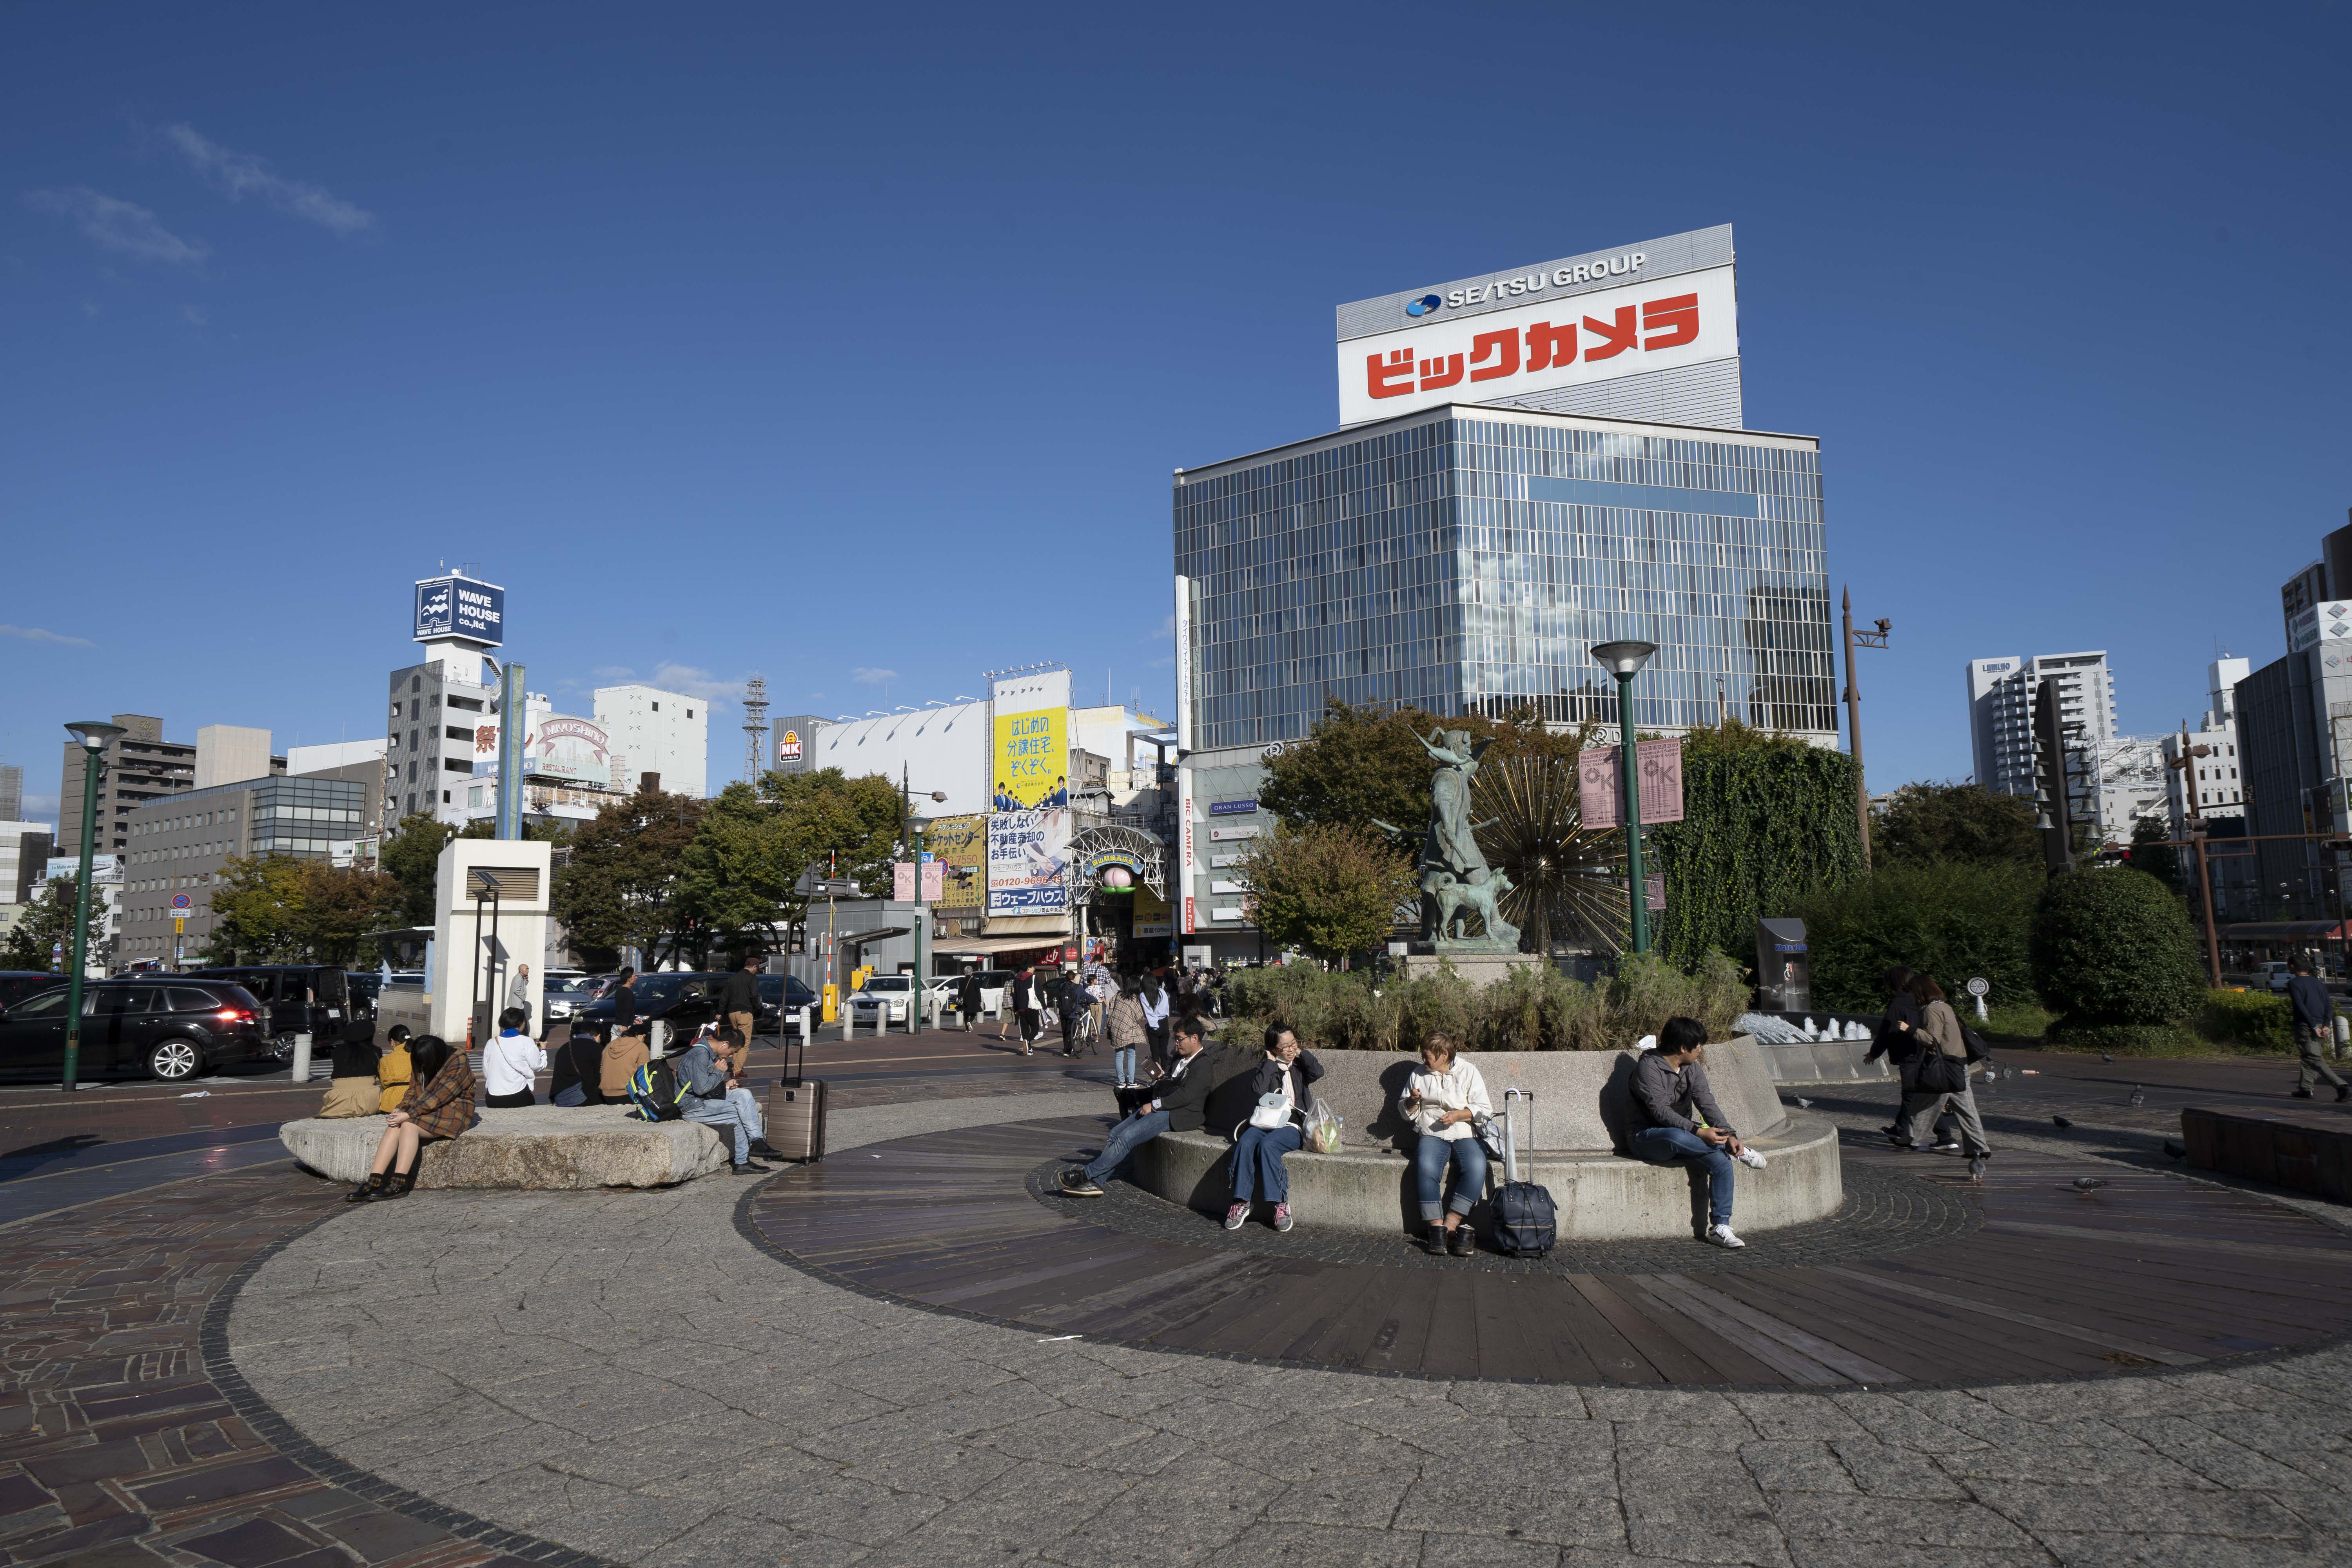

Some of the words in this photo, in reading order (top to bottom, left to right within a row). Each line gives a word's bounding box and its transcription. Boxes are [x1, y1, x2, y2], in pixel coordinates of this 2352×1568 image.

[1552, 252, 1646, 287] GROUP
[1367, 292, 1700, 399] ビックカメラ
[458, 589, 492, 608] WAVE
[459, 603, 500, 623] HOUSE
[546, 722, 605, 744] MIYOSHINO
[1012, 717, 1049, 736] はじめの
[781, 743, 800, 755] NK
[1007, 736, 1054, 757] 分譲住宅、
[1638, 743, 1678, 751] 岡山芸術交流2019
[542, 763, 577, 775] RESTAURANT
[1011, 757, 1051, 777] ぞくぞく。
[938, 821, 971, 831] チケットショップ
[991, 818, 1034, 831] 失敗しない
[931, 831, 980, 846] チケットセンター
[991, 831, 1044, 846] 不動産売却の
[946, 854, 977, 865] 3-7550
[991, 847, 1029, 860] お手伝い。
[1091, 855, 1135, 867] 岡山駅前商店街
[998, 875, 1063, 887] 0120-9696-19
[1002, 890, 1064, 905] ウェーブハウス
